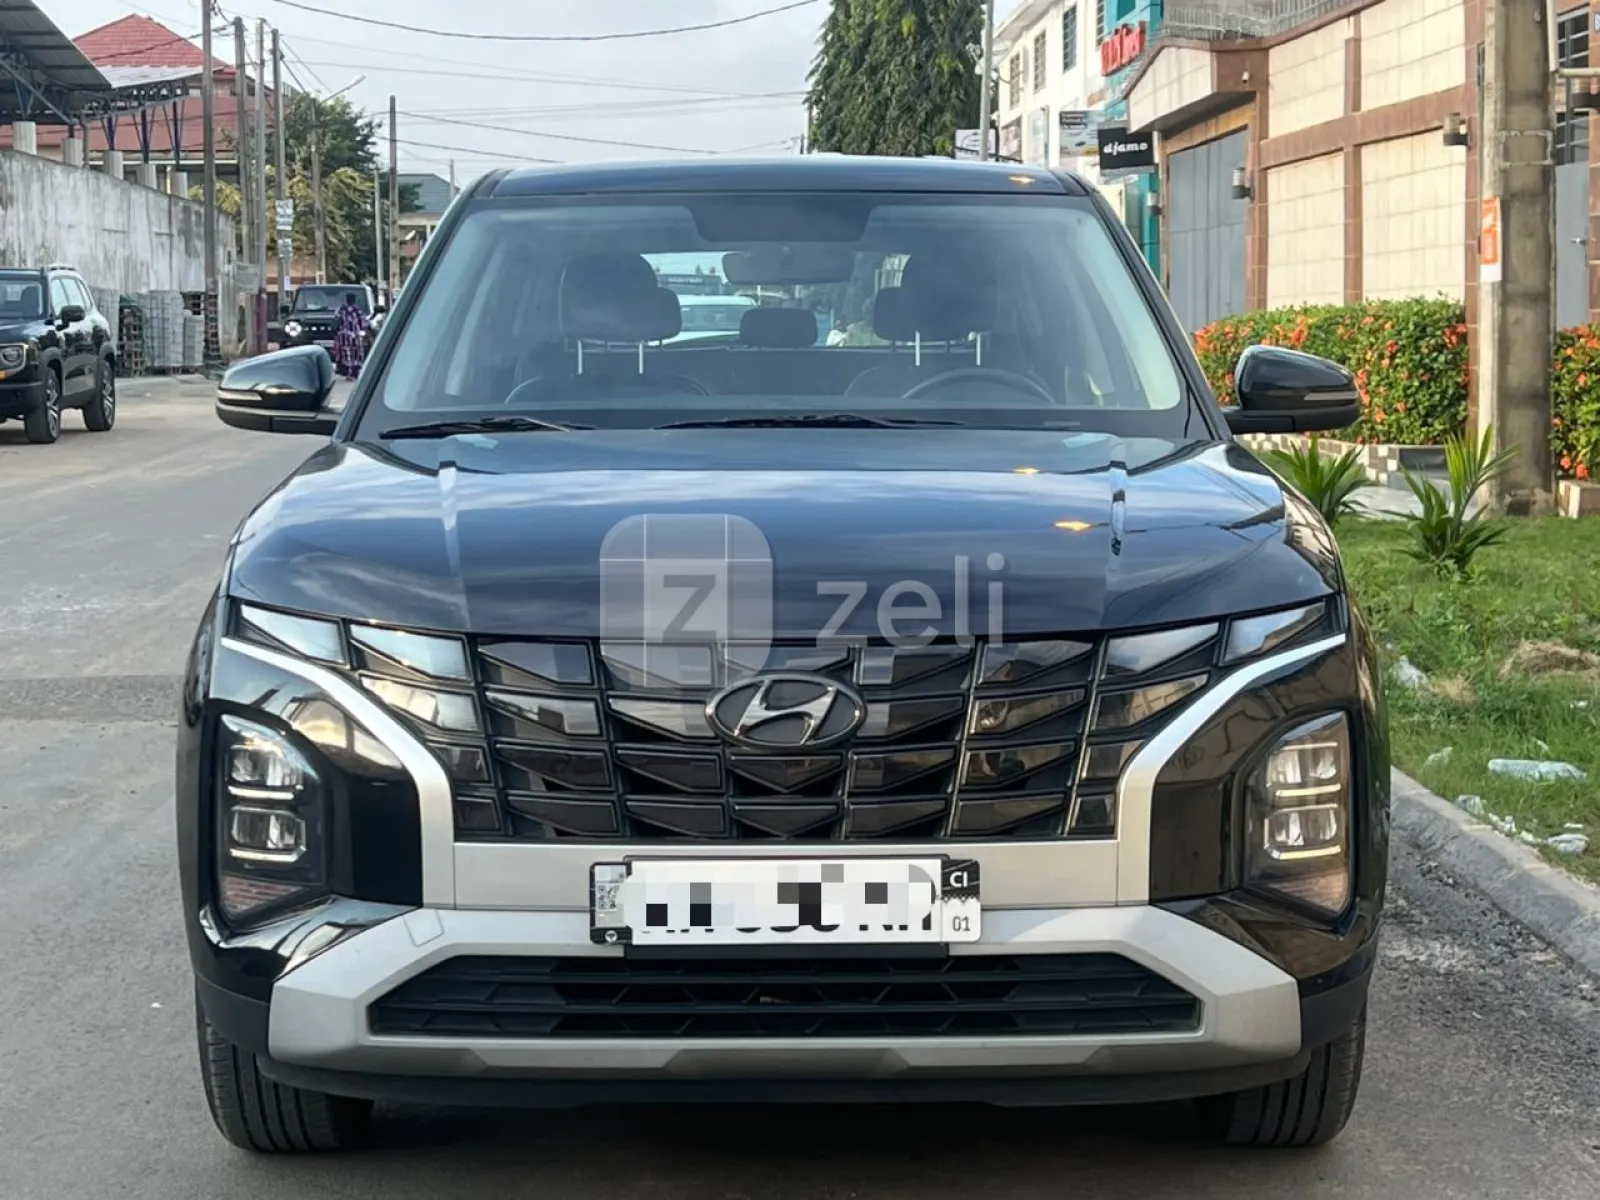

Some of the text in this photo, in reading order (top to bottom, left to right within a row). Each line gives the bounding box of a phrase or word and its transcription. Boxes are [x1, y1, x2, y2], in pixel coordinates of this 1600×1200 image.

[1103, 141, 1149, 155] djamo
[949, 870, 968, 888] CI
[952, 915, 971, 932] 01
